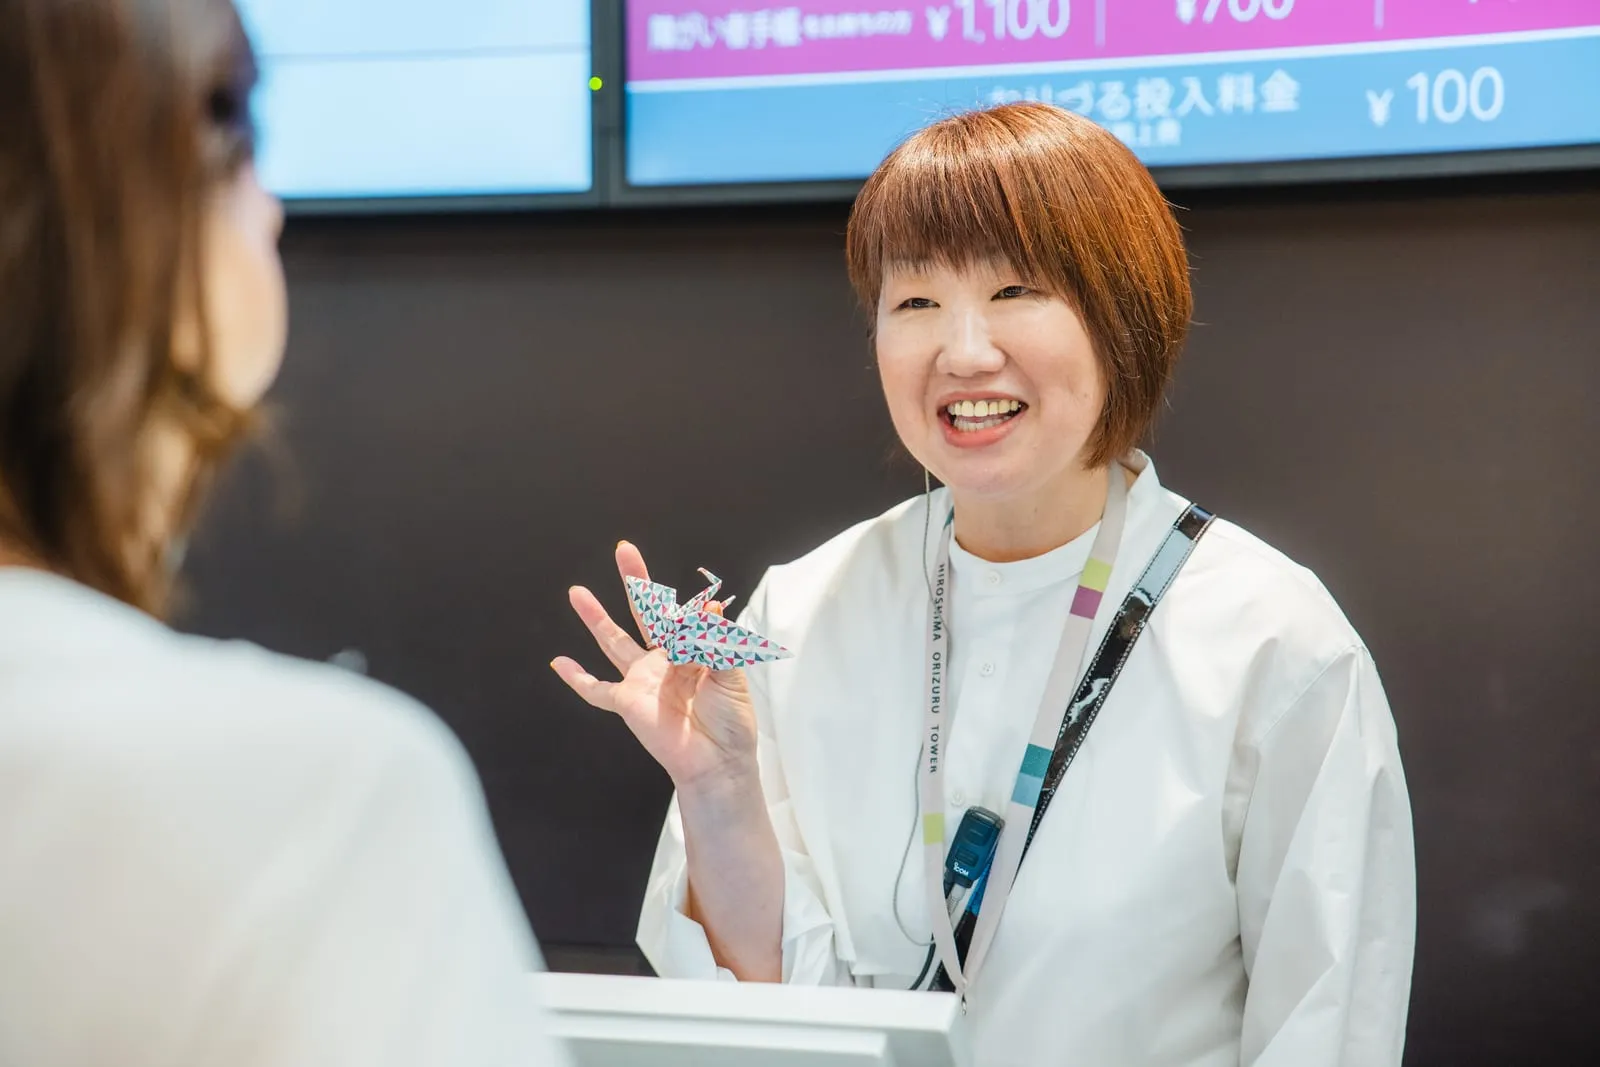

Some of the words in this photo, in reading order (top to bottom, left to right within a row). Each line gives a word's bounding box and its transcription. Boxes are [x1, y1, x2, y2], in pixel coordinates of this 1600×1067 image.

[932, 563, 945, 642] HIROSHIMA
[931, 651, 942, 715] ORIZURU
[929, 723, 941, 774] TOWER
